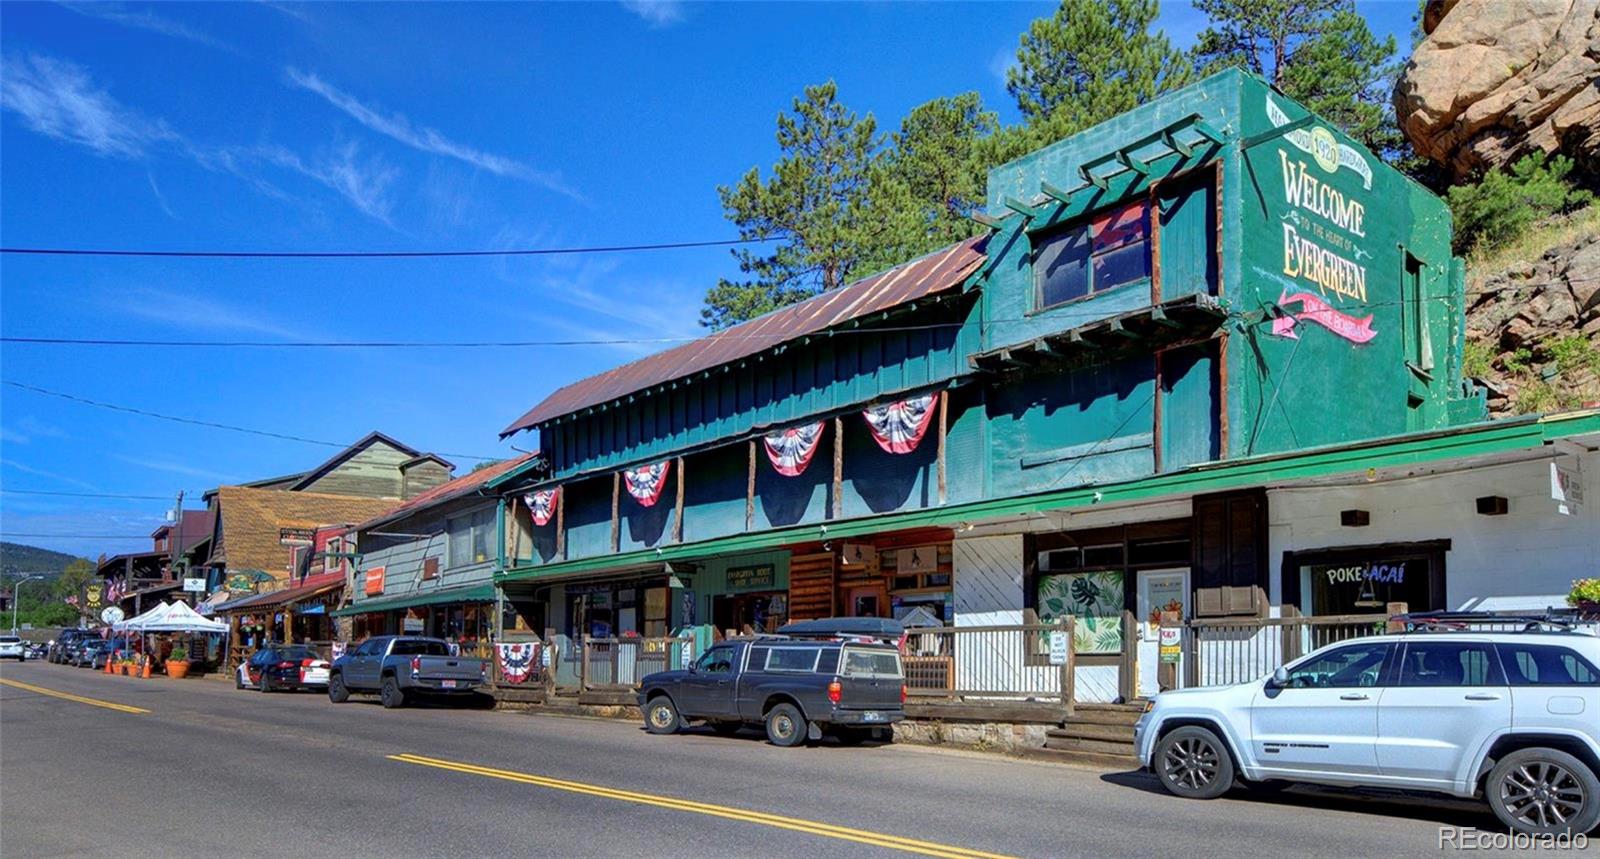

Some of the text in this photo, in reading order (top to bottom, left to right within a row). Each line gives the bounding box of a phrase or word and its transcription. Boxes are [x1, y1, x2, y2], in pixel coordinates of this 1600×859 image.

[1314, 137, 1336, 164] 1920
[1278, 148, 1366, 238] WELCOME
[1301, 217, 1310, 230] TO
[1313, 223, 1324, 239] THE
[1282, 222, 1367, 303] EVERGREEN
[1326, 566, 1362, 584] POKE
